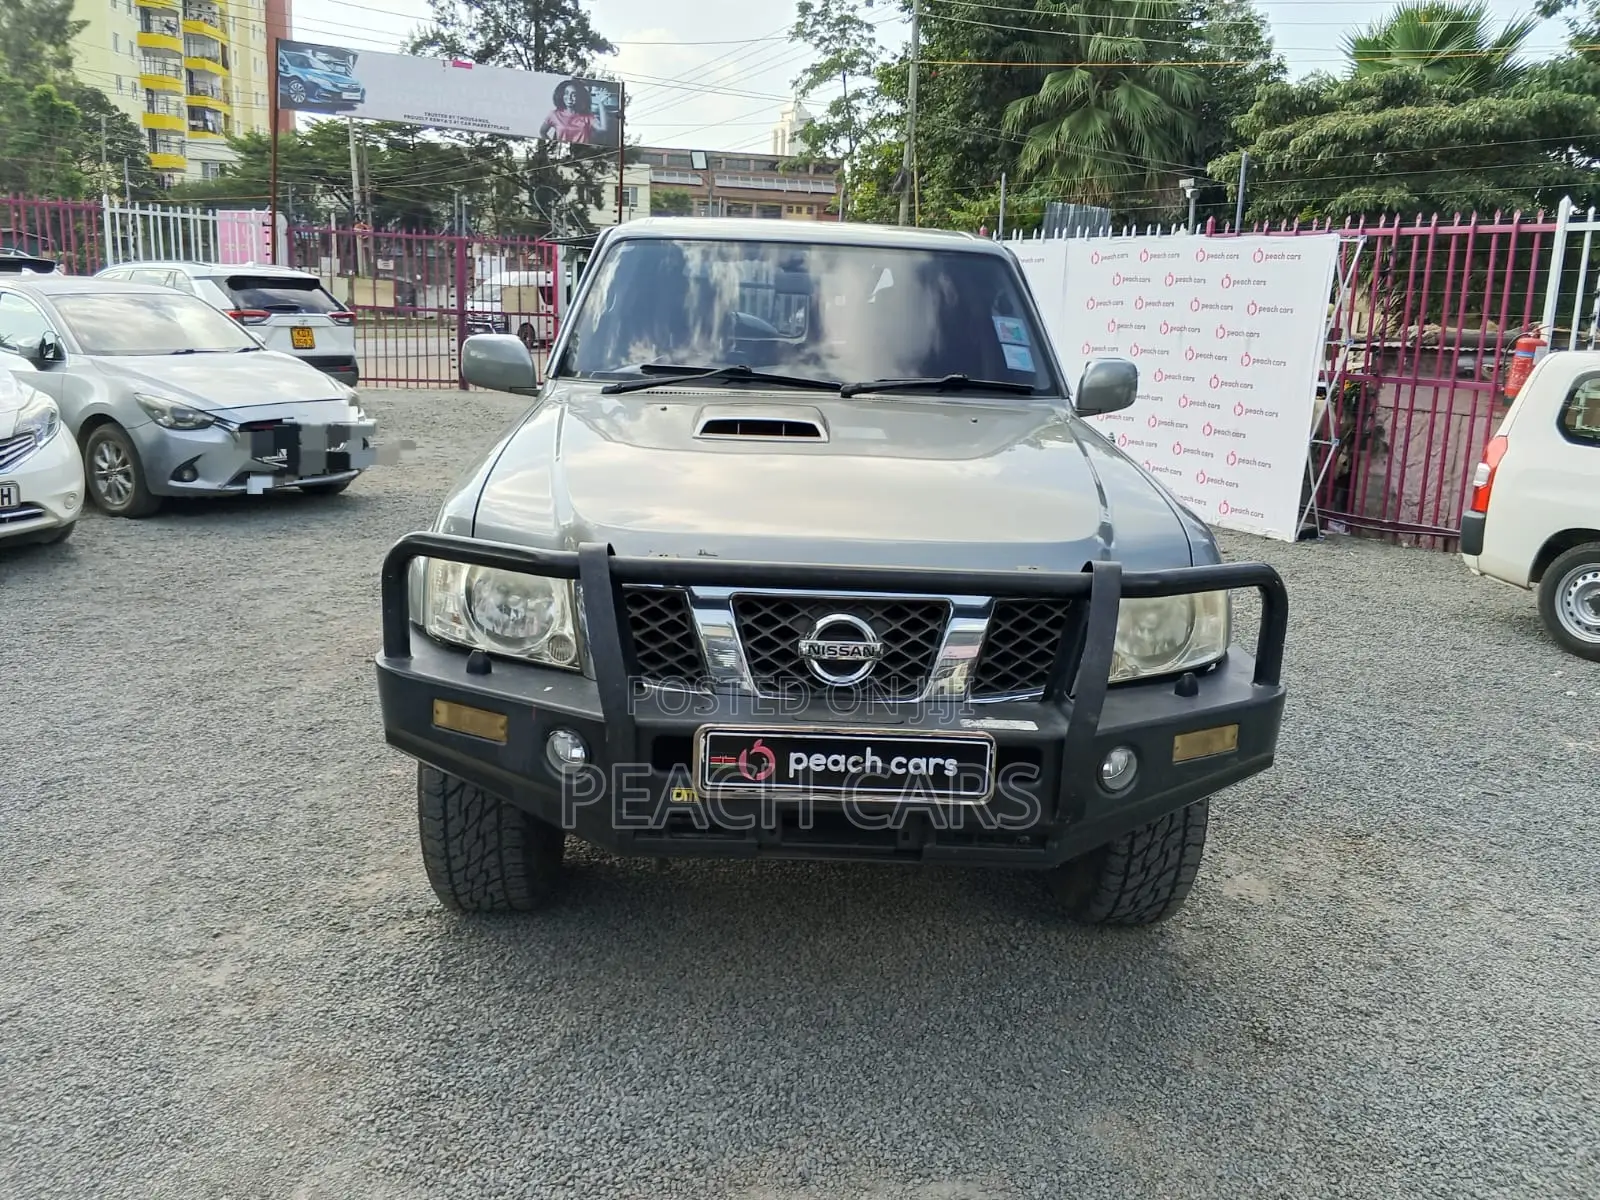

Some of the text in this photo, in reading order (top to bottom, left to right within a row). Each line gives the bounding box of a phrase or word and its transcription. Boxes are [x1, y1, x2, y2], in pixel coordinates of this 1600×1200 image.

[472, 122, 511, 131] MARKETPLACE
[1150, 251, 1166, 260] peach
[1207, 252, 1225, 260] peach
[1265, 252, 1285, 260] peach
[1175, 275, 1206, 284] peach cars
[1232, 278, 1251, 287] peach
[1201, 302, 1219, 310] peach
[1258, 305, 1278, 314] peach
[1170, 325, 1187, 333] peach
[1227, 329, 1244, 337] peach
[1140, 347, 1156, 356] peach
[1195, 351, 1213, 359] peach
[1220, 379, 1239, 388] peach
[1189, 399, 1206, 407] peach
[1245, 407, 1278, 417] peach cars
[1213, 428, 1246, 438] peach cars
[1183, 446, 1214, 458] peach cars
[1238, 457, 1271, 468] peach cars
[1207, 476, 1239, 488] peach cars
[1195, 497, 1206, 505] cars
[1230, 506, 1264, 518] peach cars
[808, 644, 875, 657] NISSAN
[787, 746, 958, 778] peach cars
